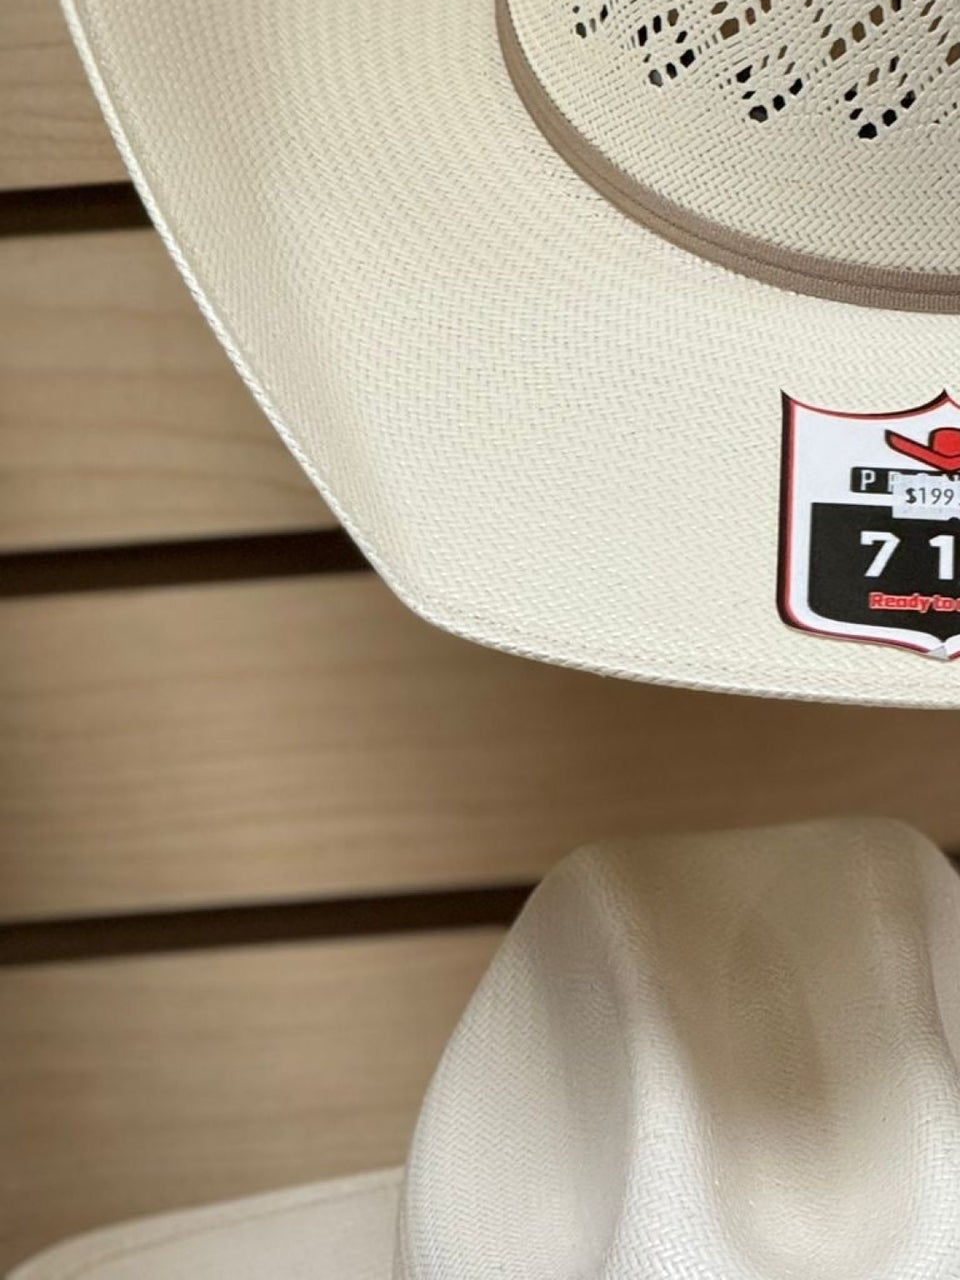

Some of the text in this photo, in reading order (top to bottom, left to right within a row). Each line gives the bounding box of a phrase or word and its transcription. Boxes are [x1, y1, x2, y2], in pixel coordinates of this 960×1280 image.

[859, 530, 901, 578] 7
[869, 591, 932, 613] Ready
[932, 594, 956, 612] to
